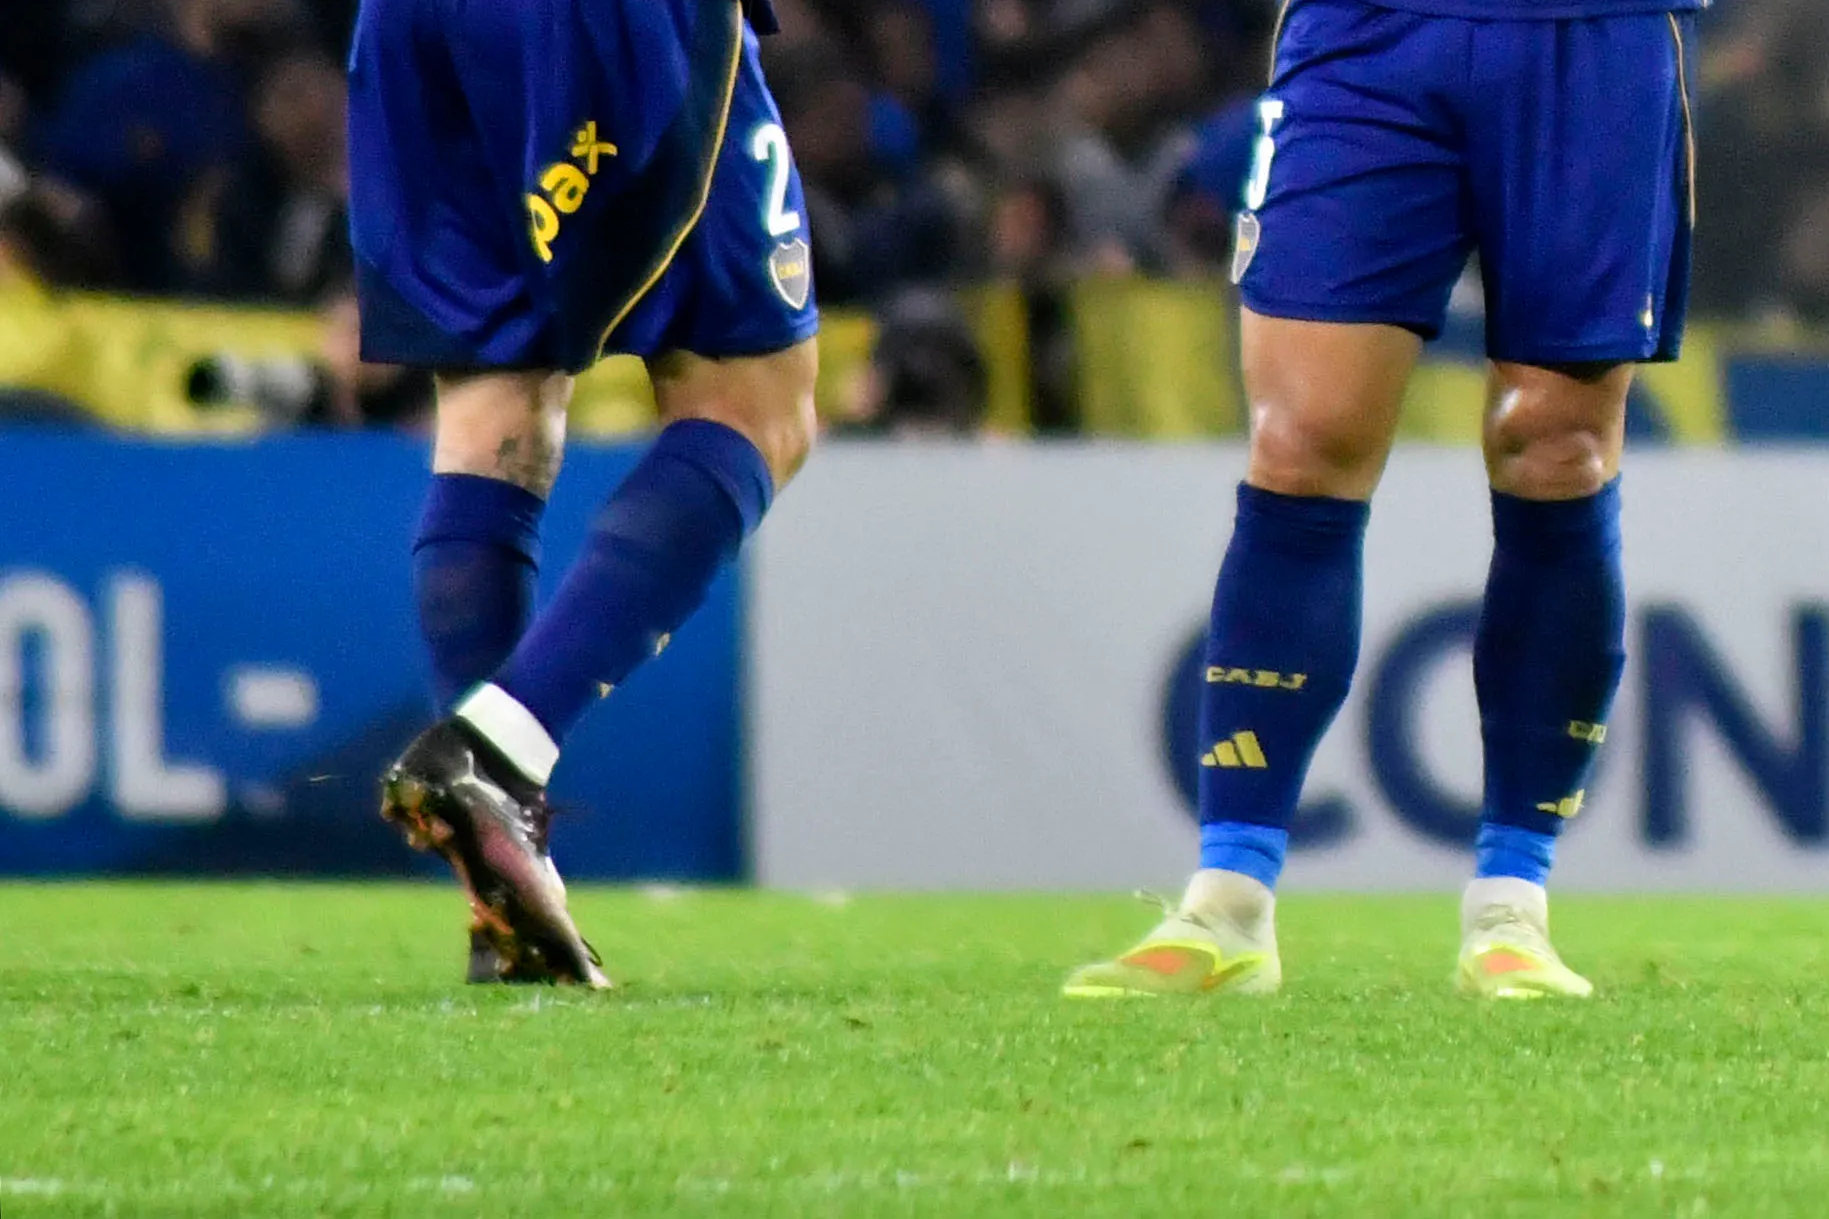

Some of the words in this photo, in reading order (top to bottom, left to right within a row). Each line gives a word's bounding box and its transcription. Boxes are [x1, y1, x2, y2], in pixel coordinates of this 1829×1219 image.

[524, 120, 618, 263] pax
[754, 124, 801, 237] 2
[1206, 665, 1307, 690] CABJ
